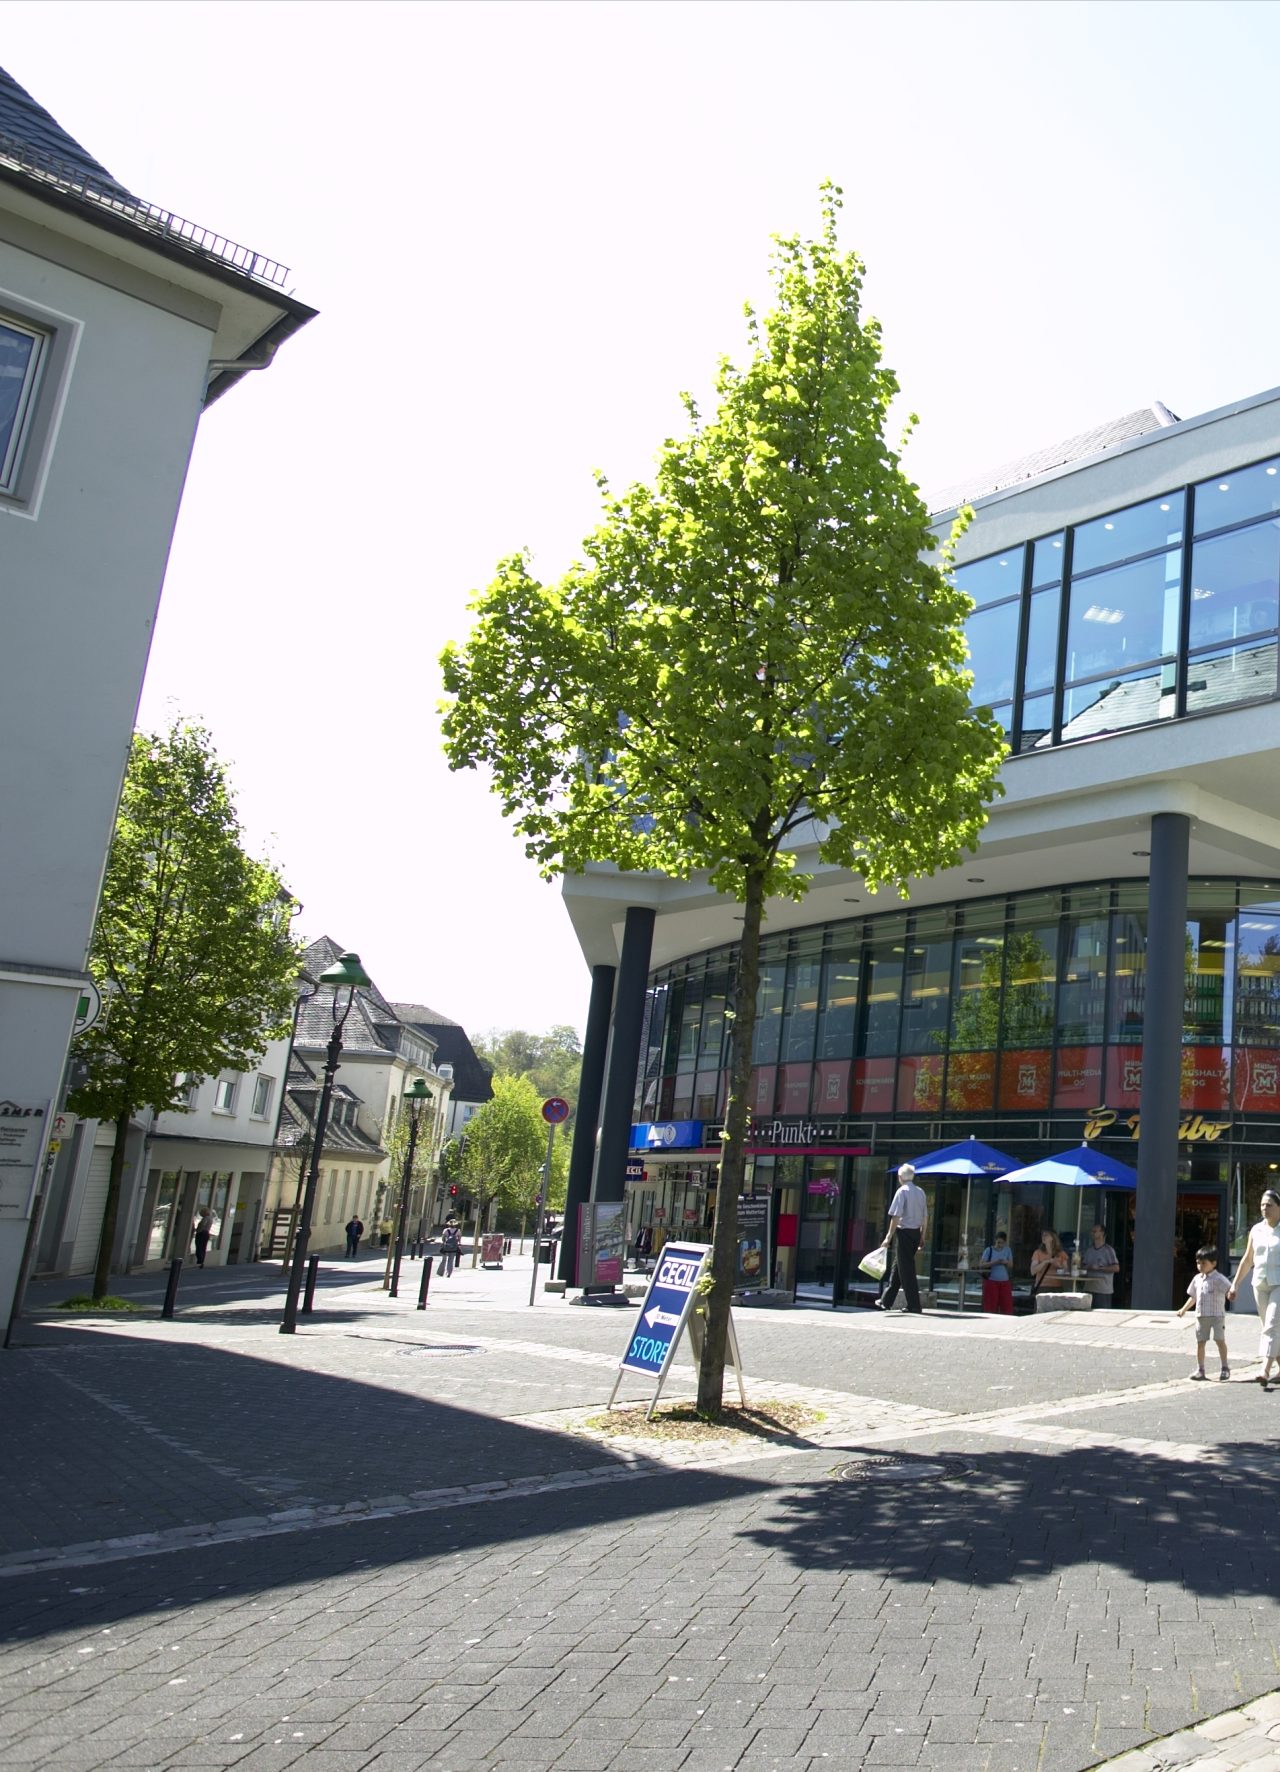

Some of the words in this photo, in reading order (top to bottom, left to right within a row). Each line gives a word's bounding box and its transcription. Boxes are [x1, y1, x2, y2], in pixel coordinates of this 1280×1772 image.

[1182, 1069, 1224, 1078] AUSHALT
[772, 1121, 813, 1143] Punkt
[1127, 1114, 1233, 1142] Tibo
[659, 1262, 695, 1286] CECIL
[630, 1336, 669, 1364] STORE
